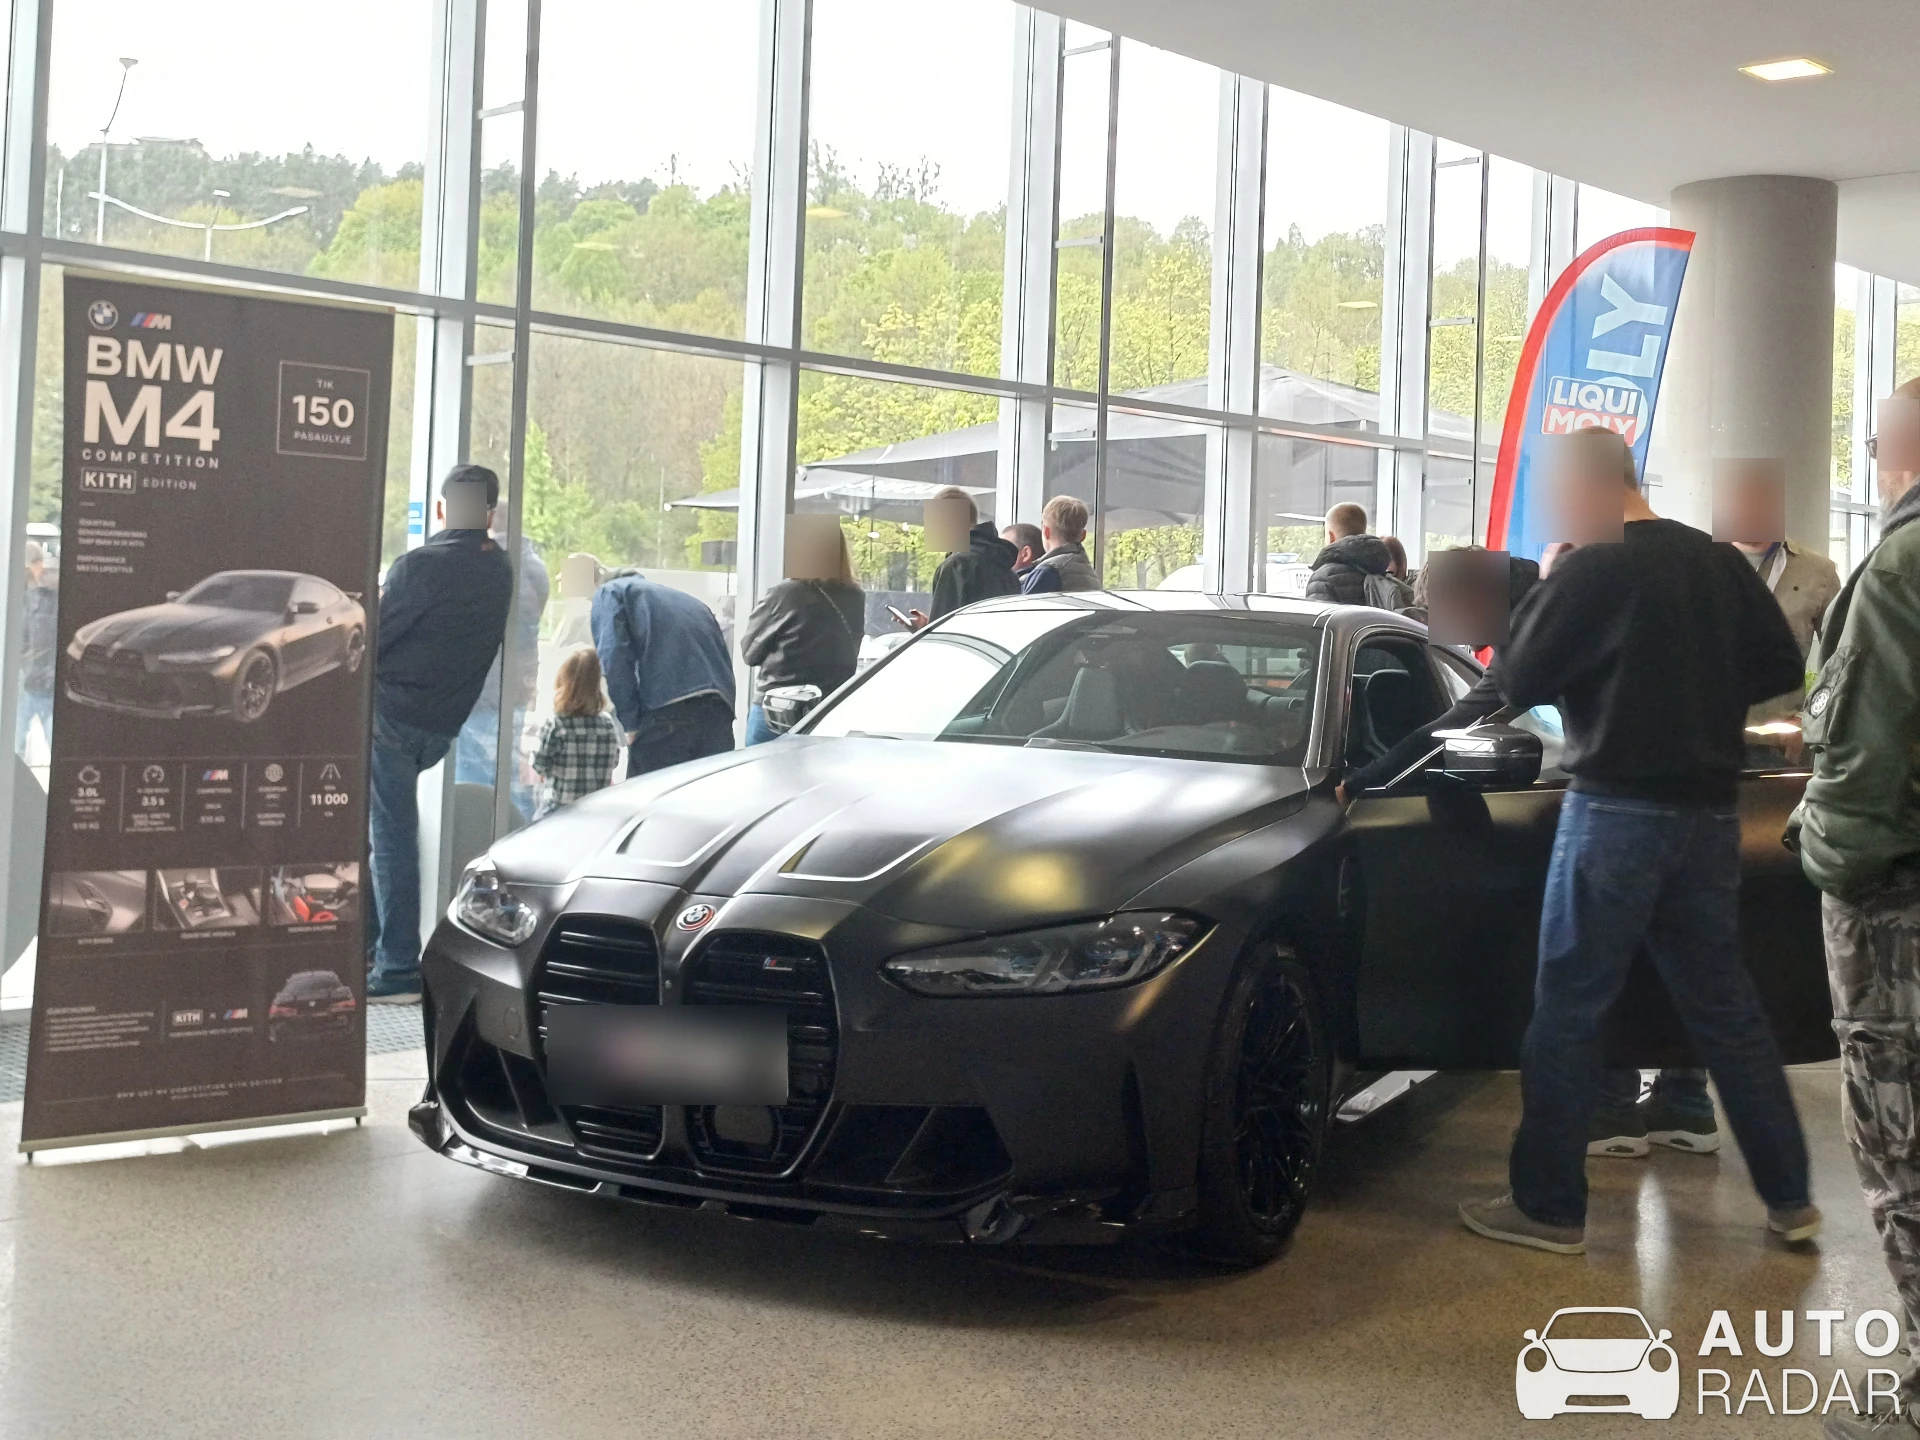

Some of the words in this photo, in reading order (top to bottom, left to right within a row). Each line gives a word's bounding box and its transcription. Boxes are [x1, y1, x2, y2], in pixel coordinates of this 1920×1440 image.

[87, 335, 224, 385] BMW
[316, 378, 335, 390] TIK
[1553, 380, 1638, 415] LIQUI
[83, 380, 220, 452] M4
[292, 394, 355, 429] 150
[293, 430, 352, 445] PASAULYJE
[82, 448, 219, 469] COMPETITION
[84, 471, 132, 489] KITH
[143, 477, 197, 491] EDITION
[310, 794, 322, 806] 11
[324, 793, 349, 805] 000
[175, 1013, 201, 1023] KITH
